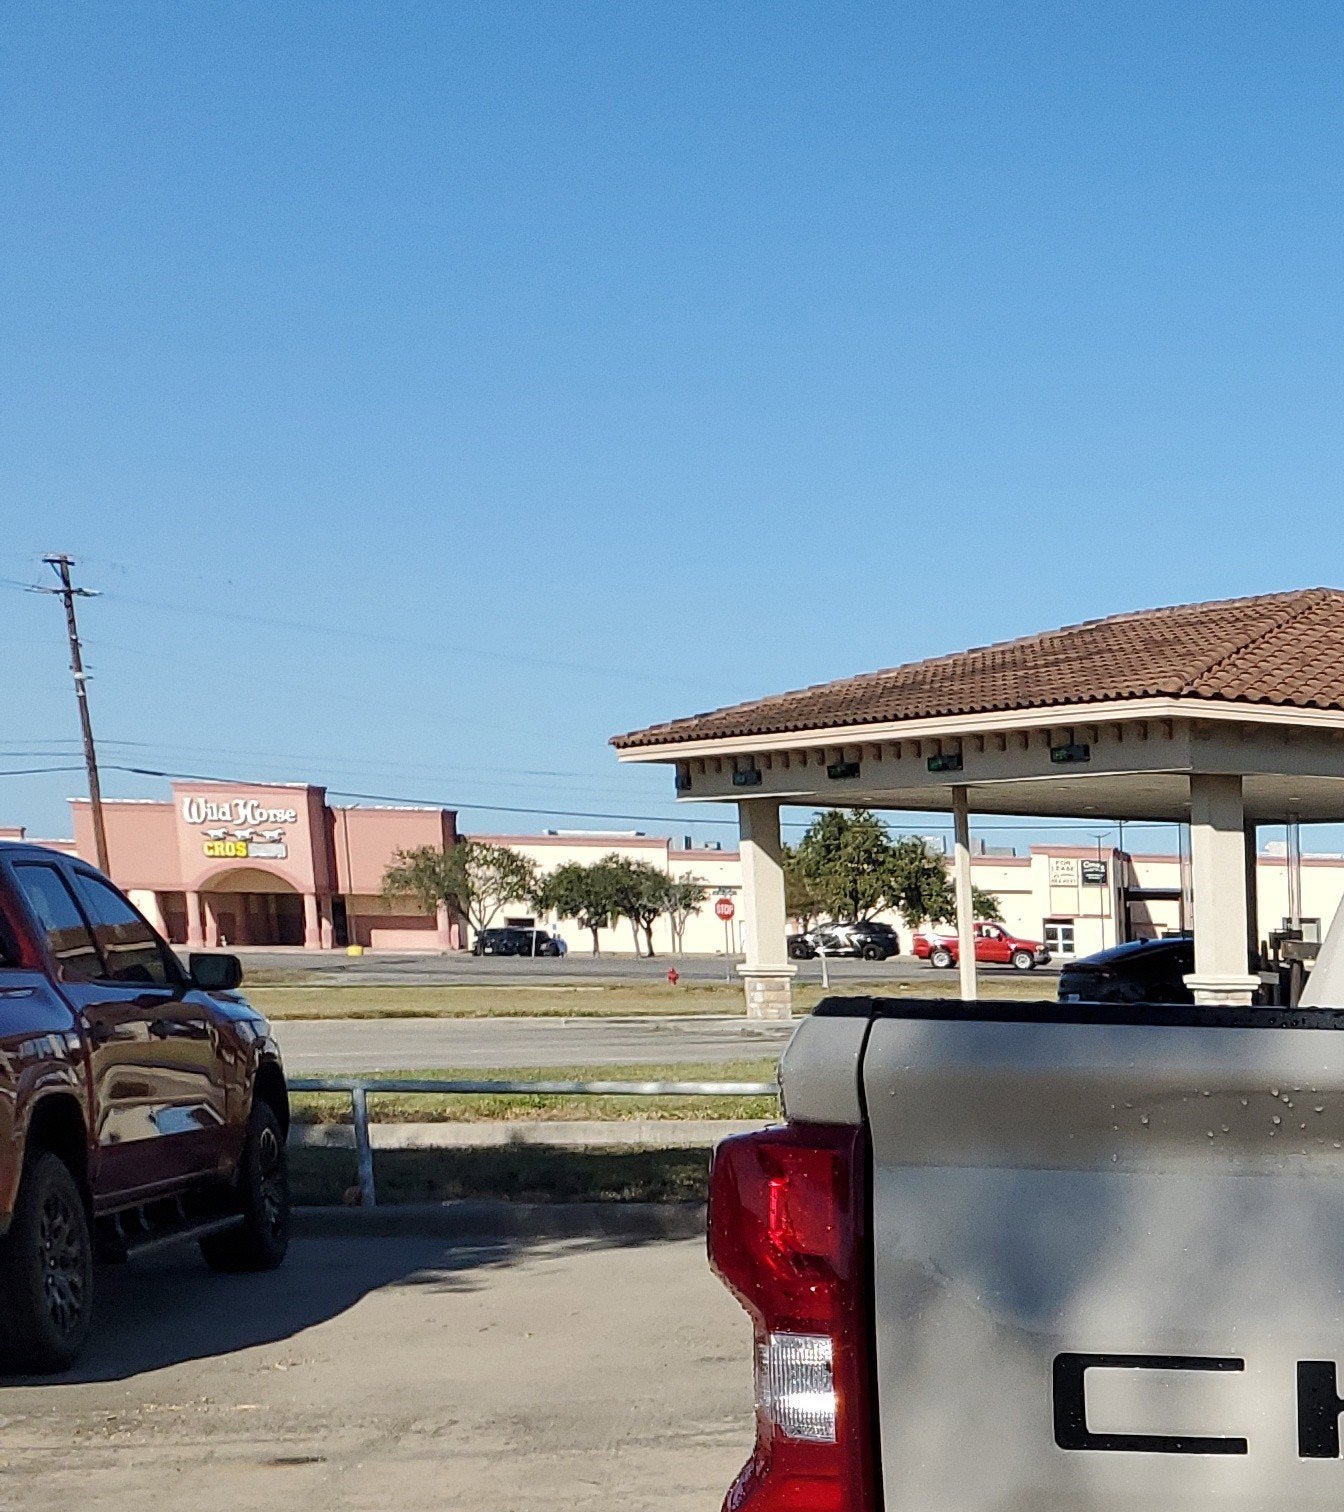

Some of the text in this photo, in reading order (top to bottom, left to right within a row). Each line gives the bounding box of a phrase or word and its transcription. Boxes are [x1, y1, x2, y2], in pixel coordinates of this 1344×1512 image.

[183, 798, 297, 825] Wild Horse
[716, 903, 734, 915] STOP
